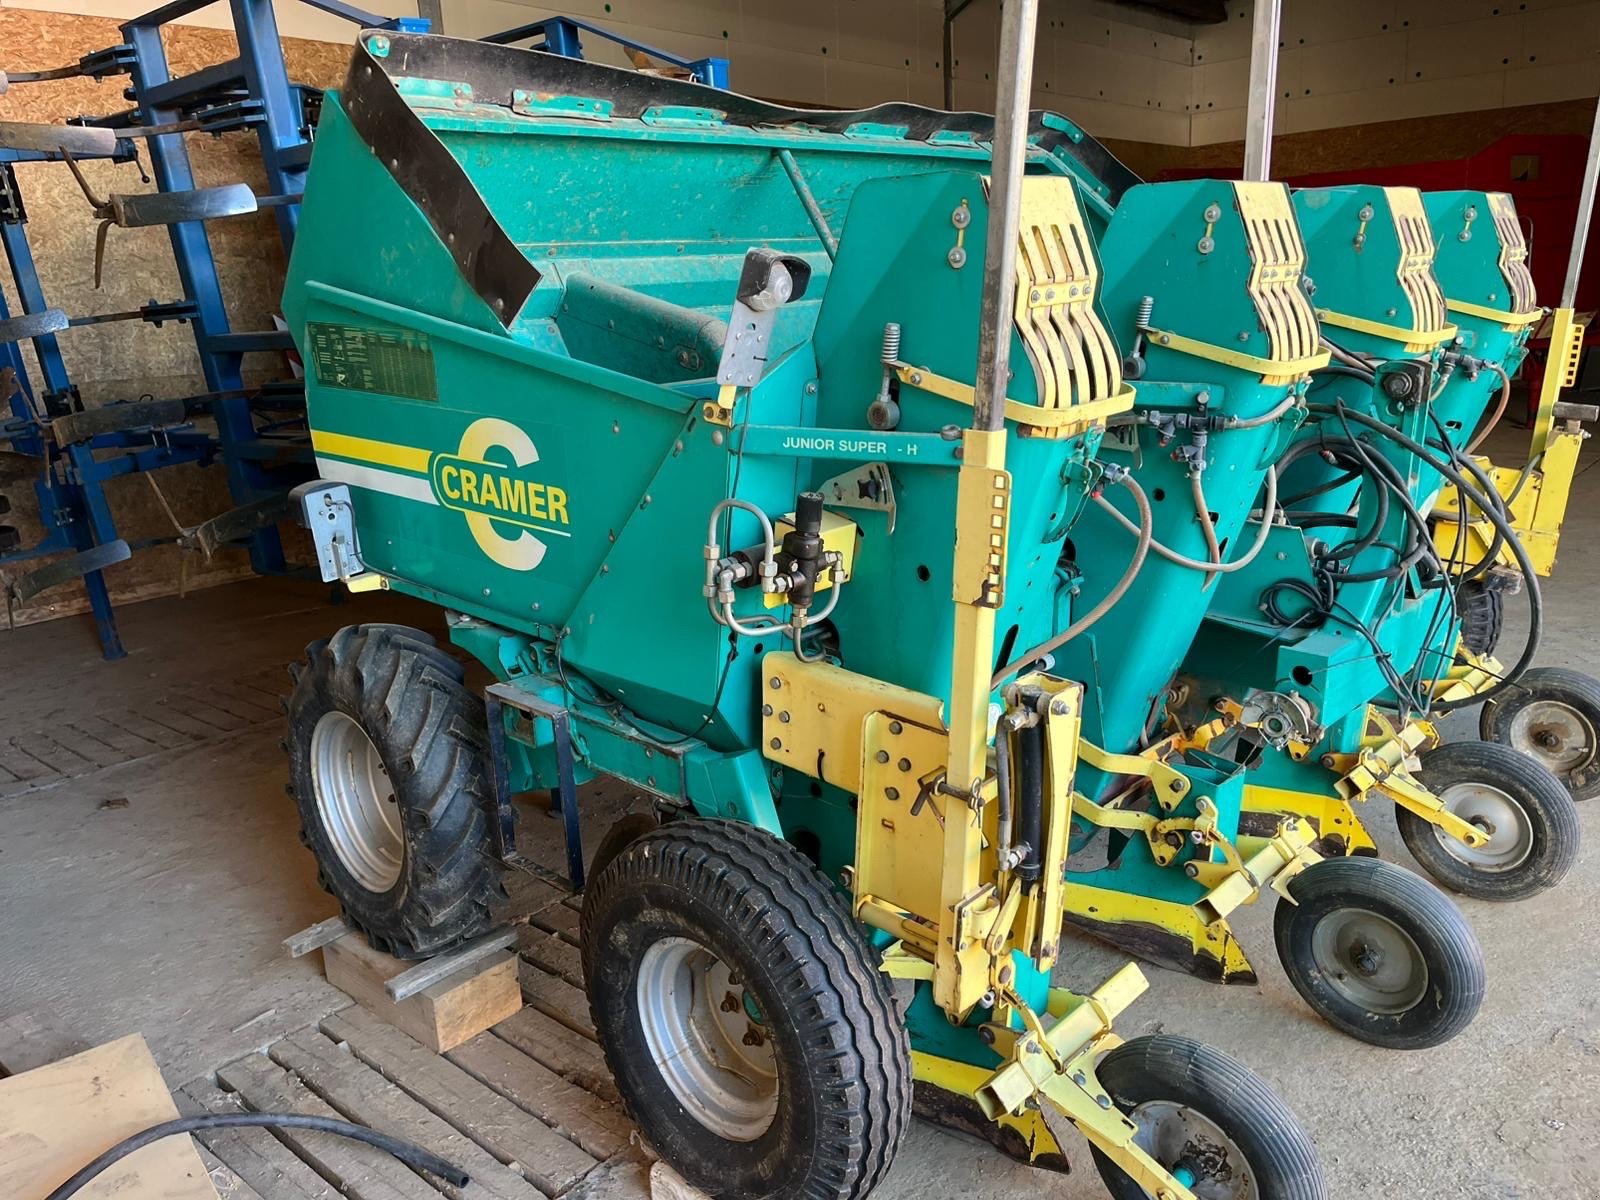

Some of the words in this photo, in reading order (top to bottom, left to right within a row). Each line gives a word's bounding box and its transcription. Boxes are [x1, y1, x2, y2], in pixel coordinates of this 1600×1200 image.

[782, 437, 835, 451] JUNIOR
[838, 439, 887, 454] SUPER
[906, 443, 918, 456] H
[441, 465, 570, 525] CRAMER
